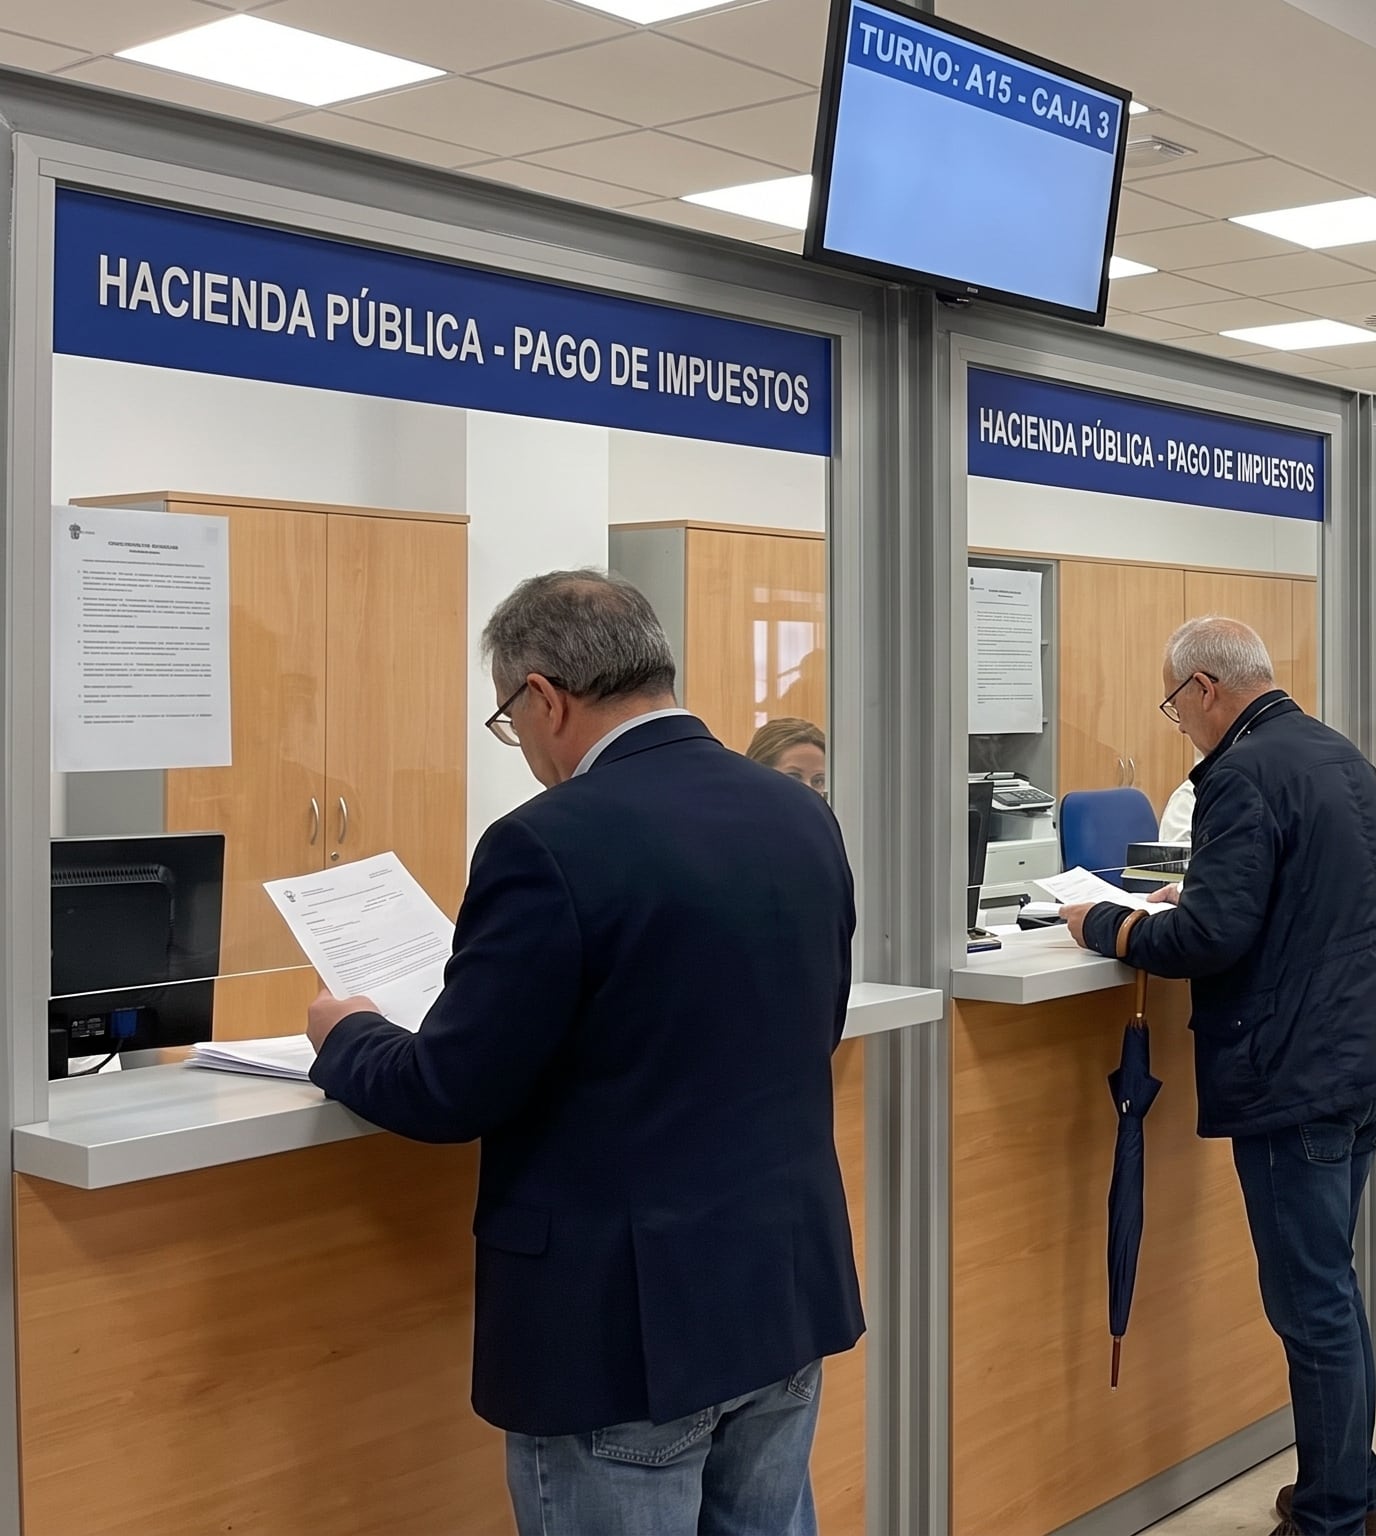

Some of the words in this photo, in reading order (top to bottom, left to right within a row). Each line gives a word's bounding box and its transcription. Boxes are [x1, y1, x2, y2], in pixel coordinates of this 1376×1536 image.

[860, 22, 959, 86] TURNO:
[965, 63, 1012, 104] A15
[1032, 88, 1091, 133] CAJA
[1097, 111, 1110, 139] 3
[99, 254, 315, 338] HACIENDA
[327, 287, 483, 364] PÚBLICA
[514, 326, 601, 382] PAGO
[611, 343, 649, 390] DE
[658, 351, 809, 415] IMPUESTOS
[980, 407, 1078, 457] HACIENDA
[1081, 419, 1155, 468] PÚBLICA
[1167, 439, 1210, 477] PAGO
[1213, 447, 1234, 480] DE
[1237, 451, 1315, 492] IMPUESTOS
